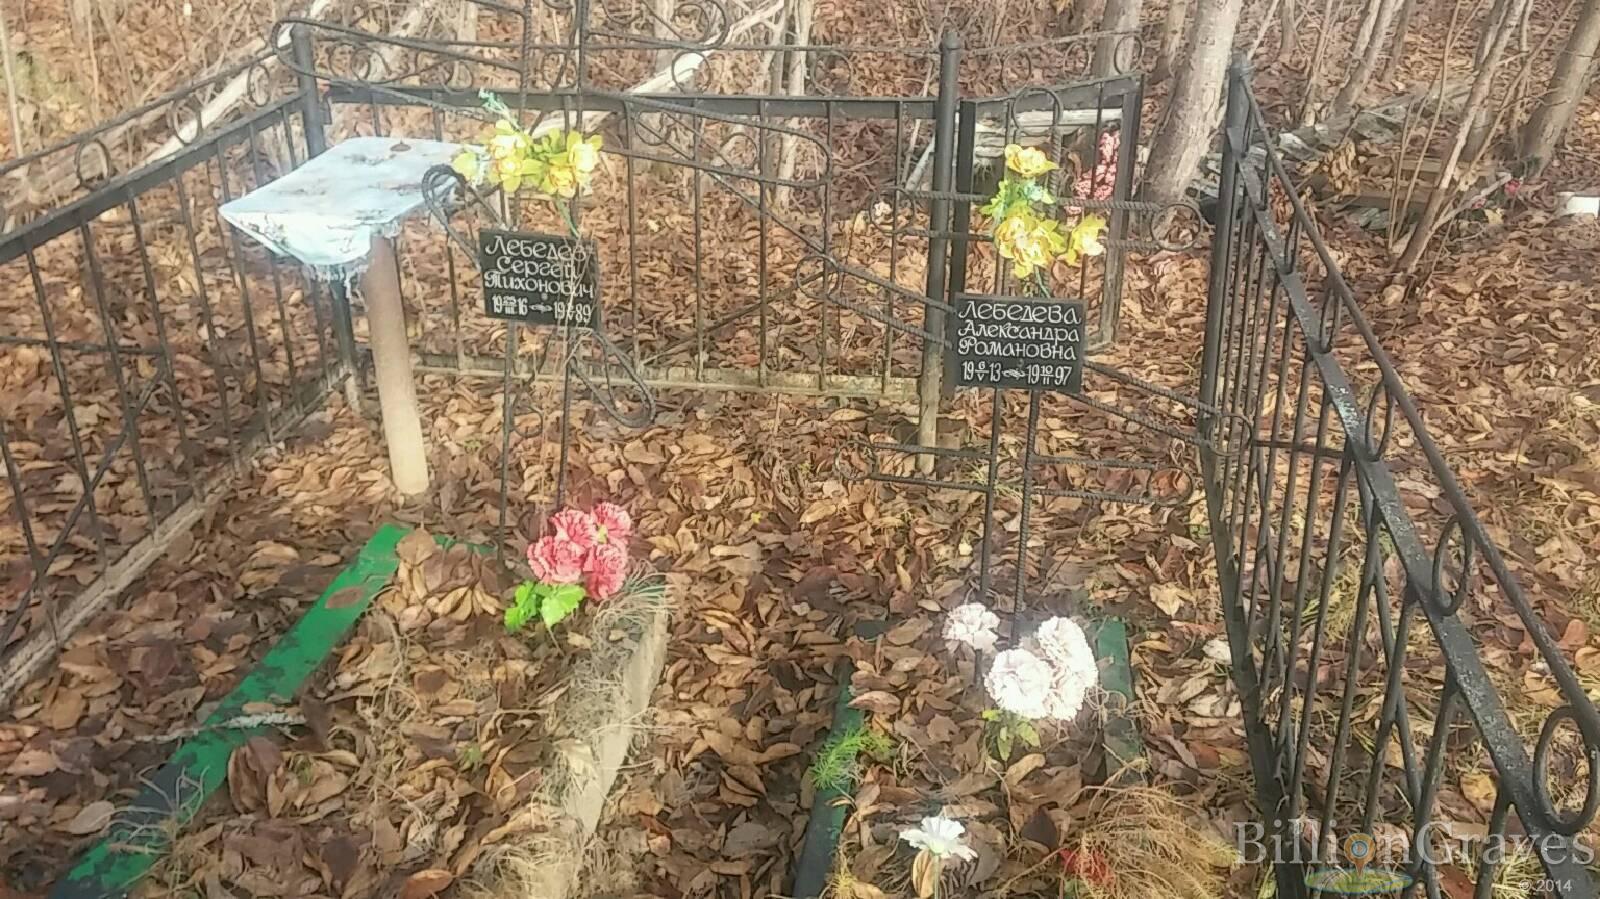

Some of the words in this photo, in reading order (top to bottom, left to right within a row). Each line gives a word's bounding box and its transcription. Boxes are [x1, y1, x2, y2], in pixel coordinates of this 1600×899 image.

[485, 235, 587, 261] Лебедев
[496, 255, 582, 280] Сергей
[484, 270, 594, 299] Тихонович
[958, 300, 1082, 325] Лебедева
[957, 319, 1080, 346] Александра
[957, 335, 1077, 361] Романовна
